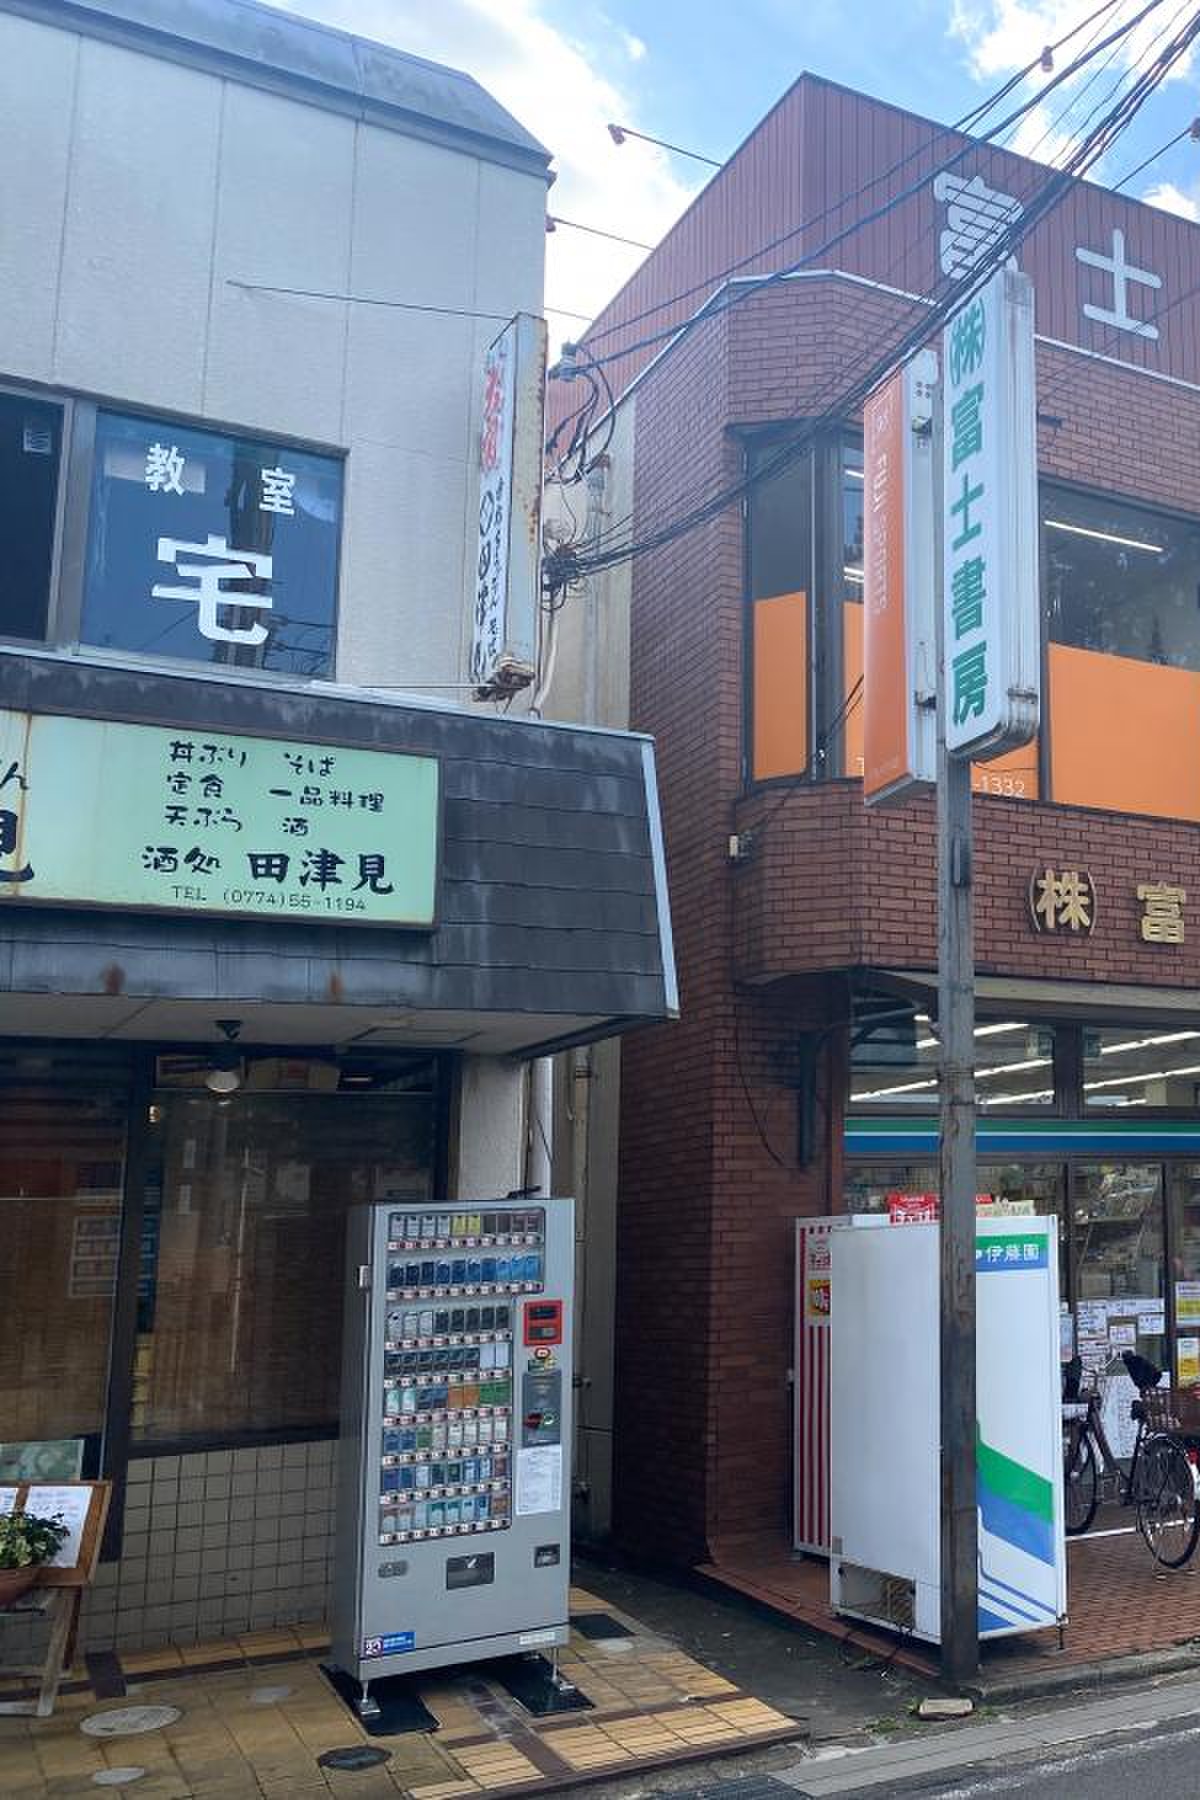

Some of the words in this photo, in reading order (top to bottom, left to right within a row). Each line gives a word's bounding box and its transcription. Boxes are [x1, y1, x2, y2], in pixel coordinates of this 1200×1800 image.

[151, 533, 273, 646] 宅
[169, 740, 249, 768] 丼ぶり
[284, 752, 338, 777] そば
[166, 771, 225, 799] 定食
[269, 786, 386, 813] 一品料理
[282, 816, 310, 837] 酒
[141, 844, 221, 876] 酒処
[246, 848, 395, 896] 田津見
[171, 885, 207, 902] TEL
